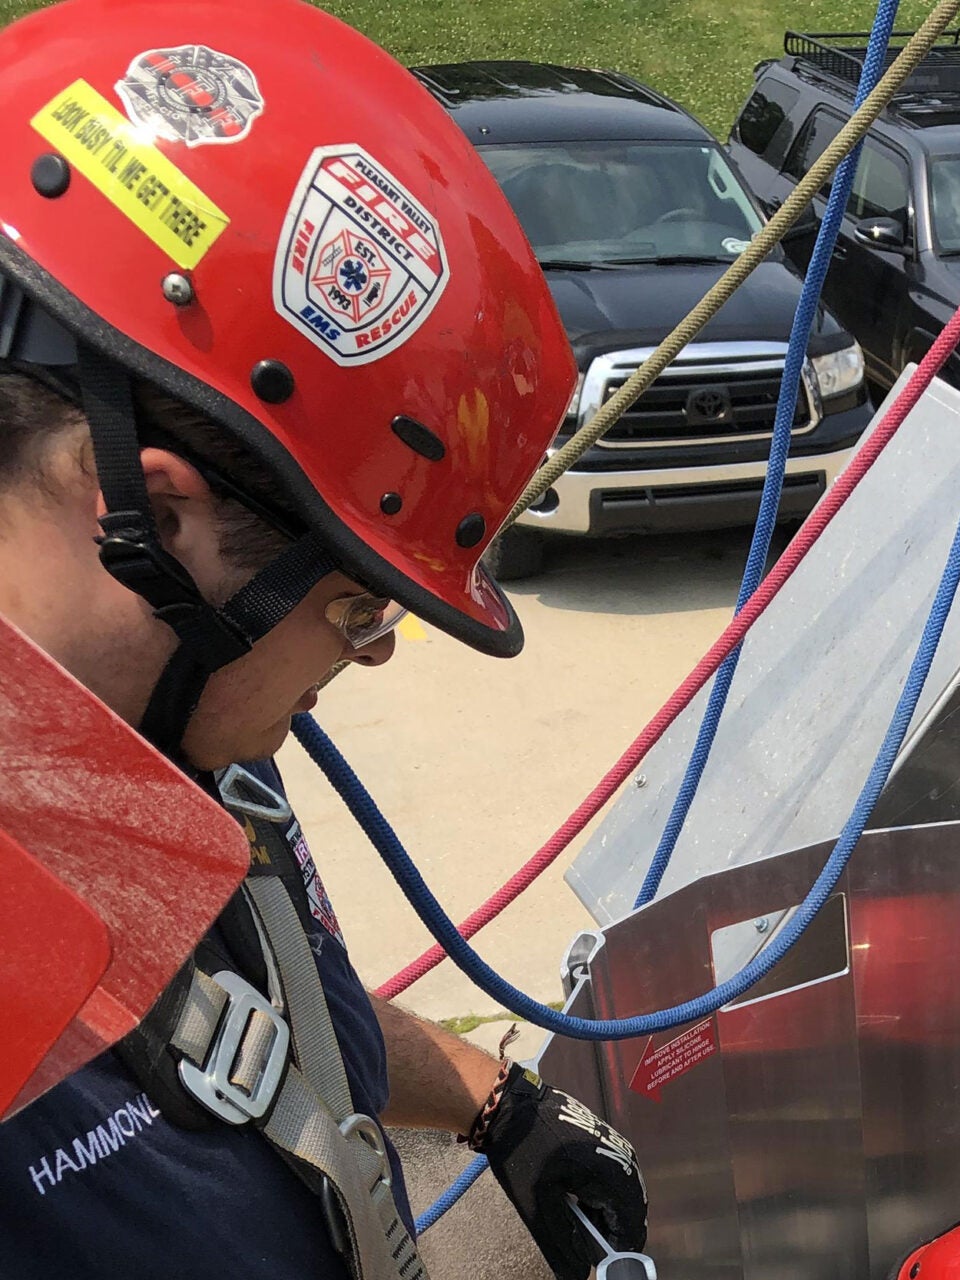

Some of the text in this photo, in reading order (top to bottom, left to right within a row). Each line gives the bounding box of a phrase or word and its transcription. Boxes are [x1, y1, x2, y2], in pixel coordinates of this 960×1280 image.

[51, 97, 91, 133] LOOK
[74, 117, 114, 156] BUSY
[117, 156, 148, 190] WE
[136, 175, 171, 212] GET
[158, 196, 208, 248] THERE
[326, 161, 436, 261] FIRE
[354, 160, 432, 235] PLEASANT VALLEY
[291, 218, 316, 276] FIRE
[342, 195, 415, 261] DISTRICT
[353, 240, 377, 267] EST.
[327, 284, 352, 311] 1993
[299, 305, 342, 342] EMS
[355, 289, 418, 350] RESCUE
[644, 1044, 671, 1066] IMPROVE
[646, 1071, 671, 1090] BEFORE
[670, 1063, 684, 1076] AND
[683, 1051, 702, 1068] AFTER
[650, 1038, 710, 1080] LUBRICANT TO HINGE
[656, 1034, 702, 1067] APPLY SILICONE
